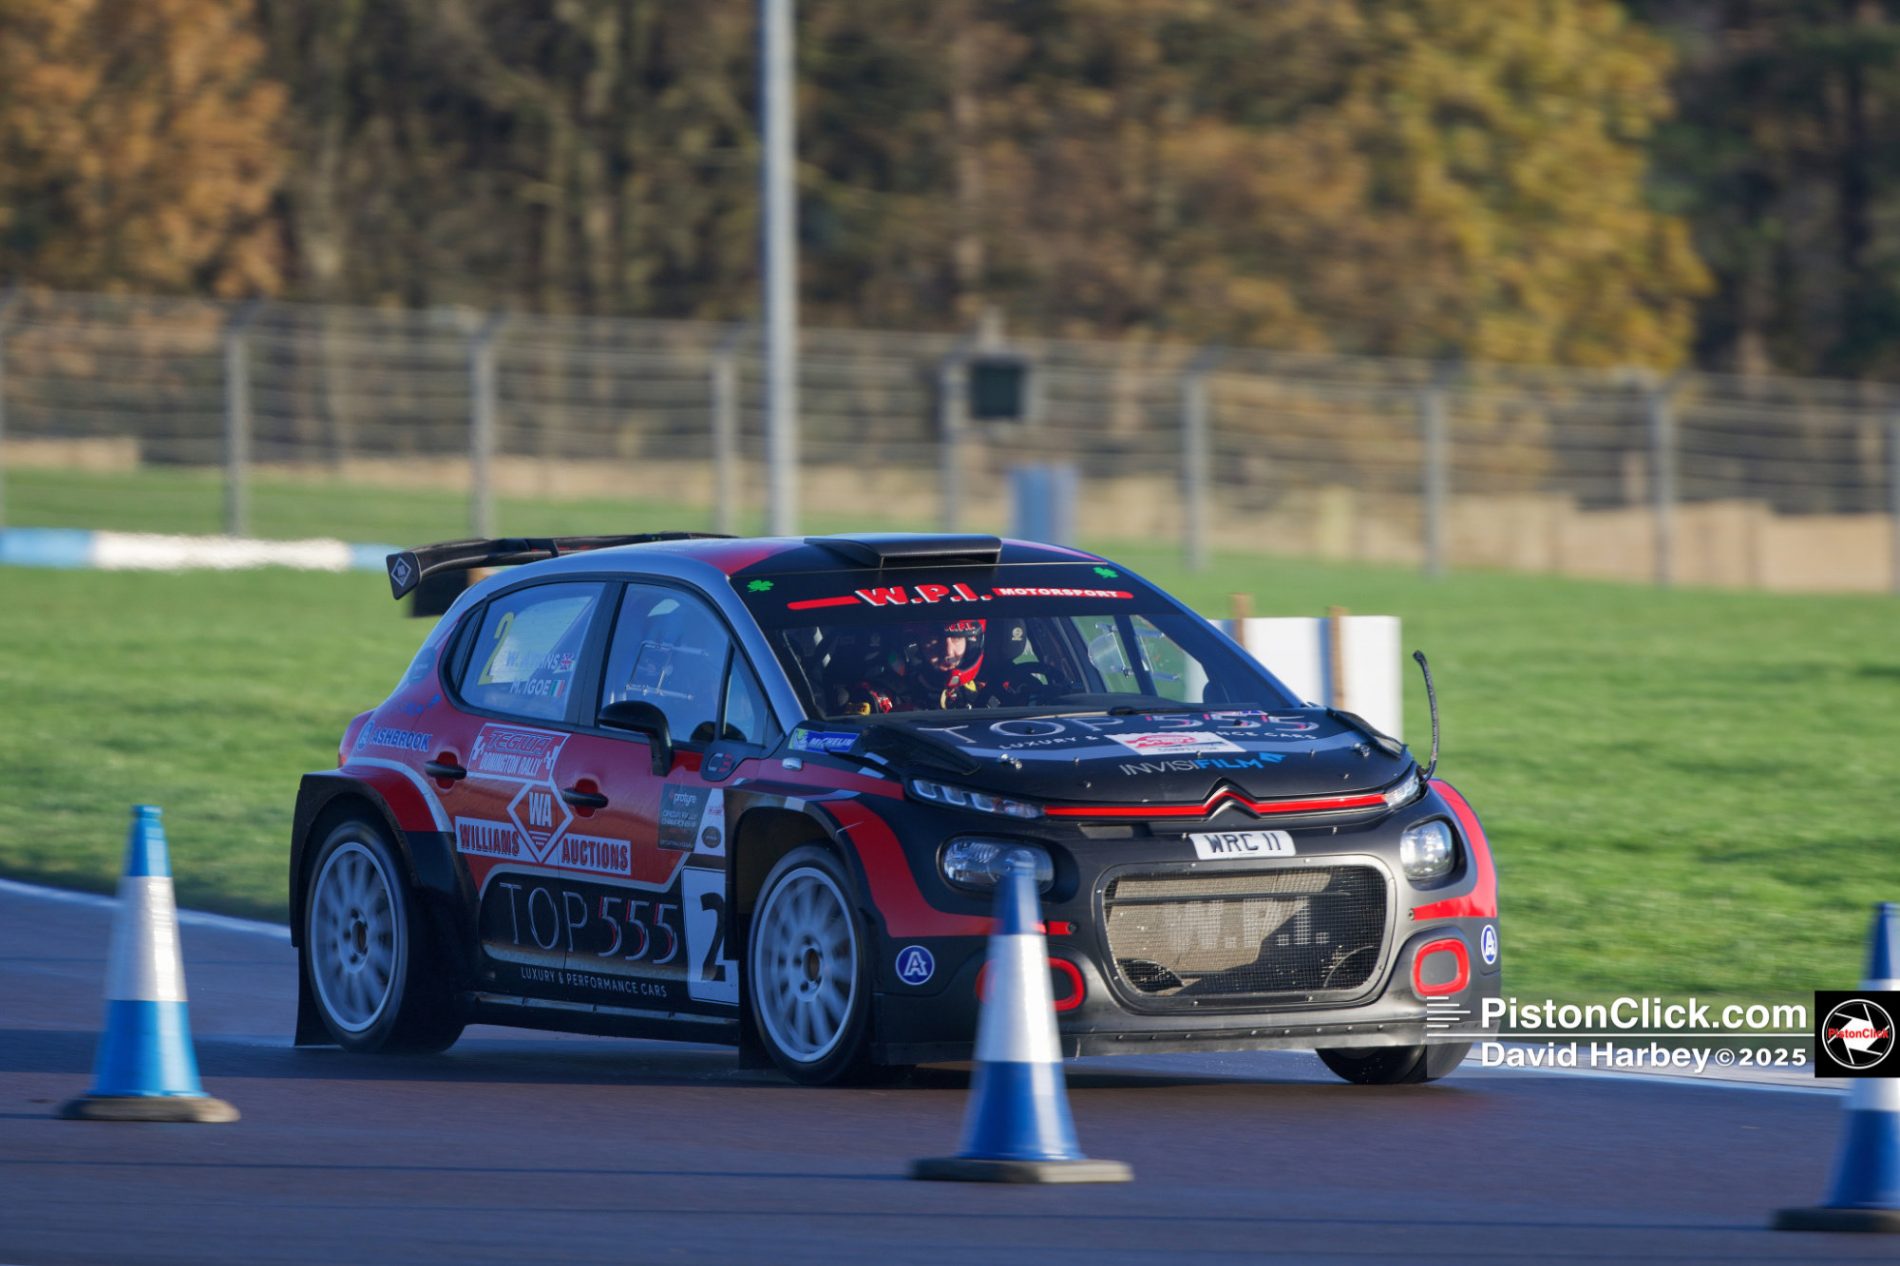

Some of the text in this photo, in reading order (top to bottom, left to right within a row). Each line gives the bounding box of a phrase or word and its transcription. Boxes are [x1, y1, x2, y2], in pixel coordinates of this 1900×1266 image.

[855, 582, 1119, 607] W.P.I. MOTORSPORT
[477, 611, 516, 687] 2
[371, 727, 434, 753] ASHBROOK
[917, 716, 1125, 745] TOP
[1145, 712, 1320, 732] 555
[999, 736, 1083, 750] LUXURY
[1085, 734, 1100, 742] &
[1119, 757, 1265, 777] INVISIFILM
[528, 791, 553, 828] WA
[459, 823, 521, 857] WILLIAMS
[561, 837, 629, 872] AUCTIONS
[1203, 833, 1259, 854] WRC
[498, 881, 679, 965] TOP 555
[519, 966, 669, 998] LUXURY & PERFORMANCE CARS
